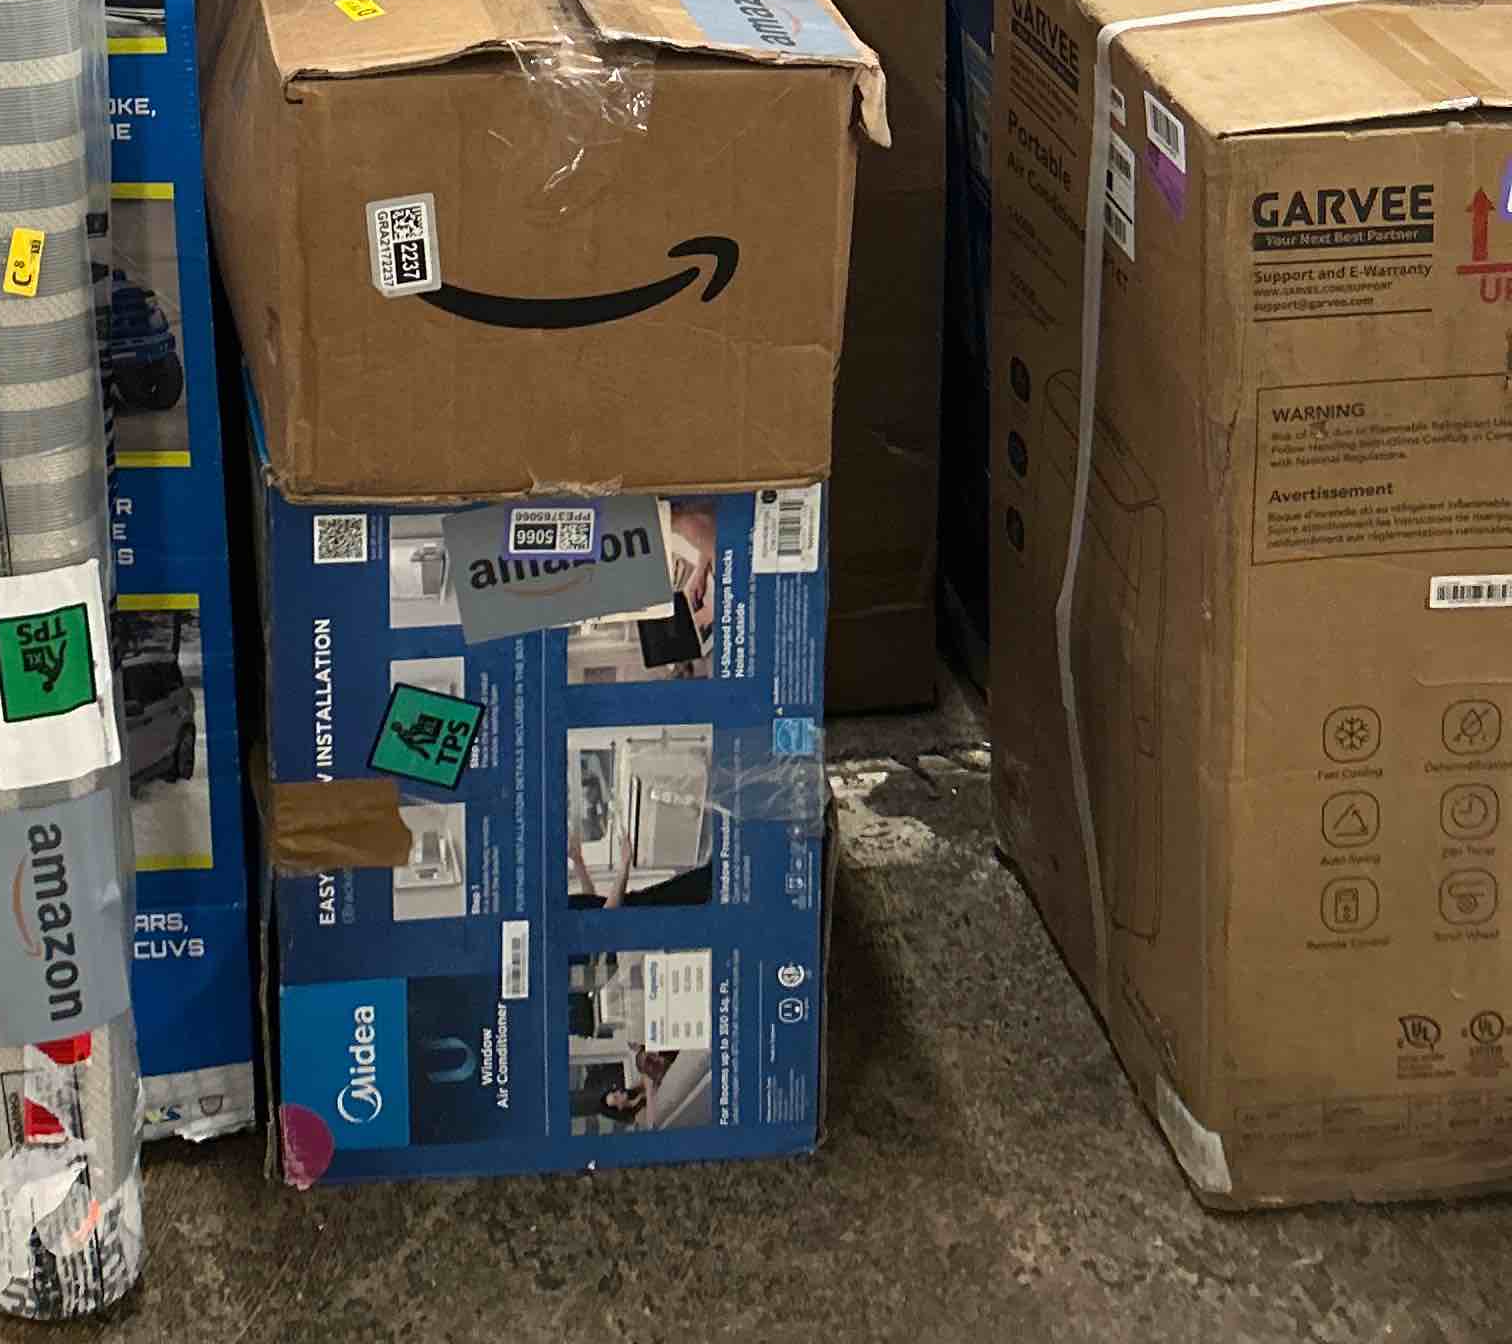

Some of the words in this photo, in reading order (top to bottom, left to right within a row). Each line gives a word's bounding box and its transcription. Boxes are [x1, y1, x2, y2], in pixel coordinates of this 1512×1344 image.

[1007, 109, 1072, 192] Portable
[1251, 183, 1434, 229] GARVEE
[377, 210, 395, 287] GRA2172237
[1367, 229, 1420, 241] Partner
[400, 242, 421, 279] 2237
[1253, 268, 1314, 285] Support
[1317, 267, 1345, 280] and
[1349, 264, 1433, 280] E-Warranty
[1272, 402, 1366, 423] WARNING
[1269, 482, 1394, 504] Avertissement
[515, 529, 555, 544] 5066
[469, 526, 652, 591] amaon
[722, 549, 734, 585] Blocks
[721, 587, 734, 624] Design
[734, 601, 745, 645] Outside
[15, 620, 67, 644] TPS
[720, 624, 732, 679] U-Shaped
[734, 645, 745, 679] Noise
[314, 617, 335, 767] INSTALLATION
[435, 718, 471, 766] TPS
[319, 872, 337, 926] EASY
[26, 821, 84, 1022] amazon
[134, 937, 205, 959] CUVS
[342, 1006, 381, 1114] Midea
[479, 1027, 494, 1087] Window
[496, 1001, 509, 1085] Conditioner
[497, 1086, 510, 1110] Air
[719, 1069, 729, 1106] Rooms
